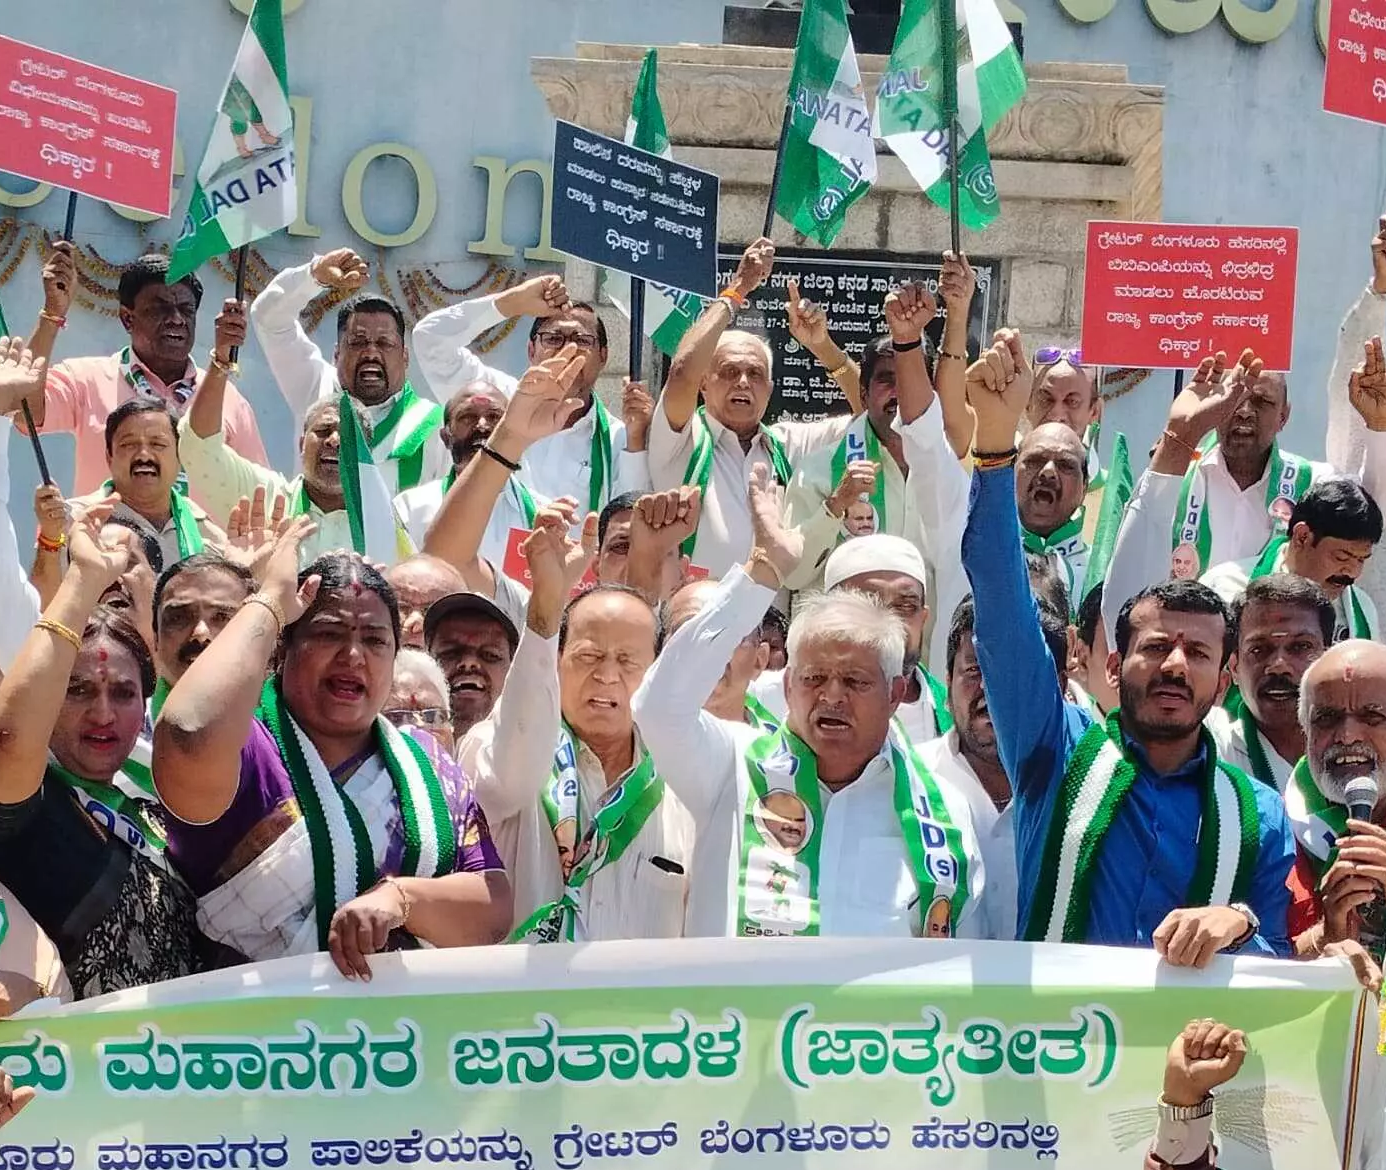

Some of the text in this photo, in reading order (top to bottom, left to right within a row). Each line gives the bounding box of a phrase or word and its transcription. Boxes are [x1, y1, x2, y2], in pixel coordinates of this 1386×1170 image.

[104, 1008, 1117, 1107] ಮಹಾನಗರ ಜನತಾದಳ (ಜಾತ್ಯತೀತ)
[554, 1121, 677, 1170] ಗ್ರೇಟರ್
[700, 1118, 891, 1155] ಬೆಂಗಳೂರು
[912, 1115, 1060, 1160] ಹೆಸರಿನಲ್ಲಿ
